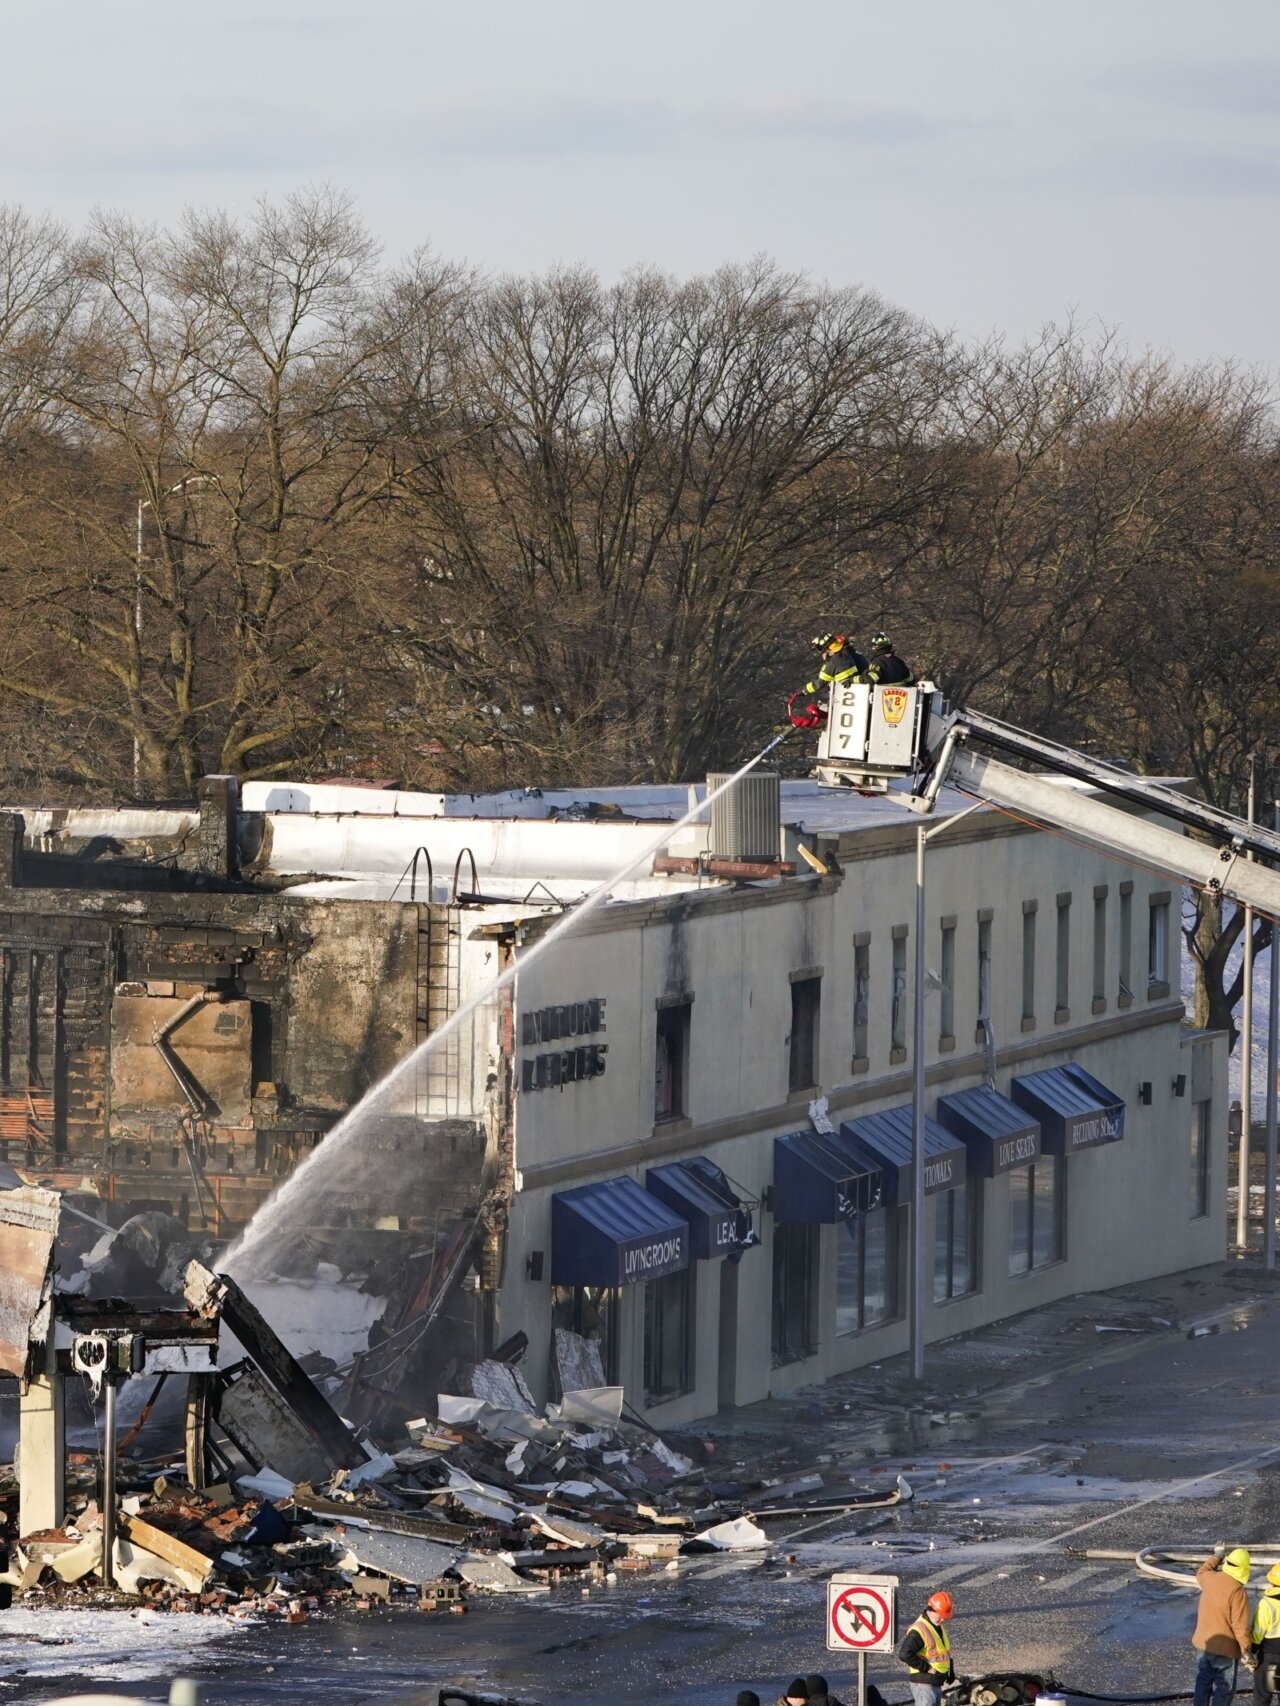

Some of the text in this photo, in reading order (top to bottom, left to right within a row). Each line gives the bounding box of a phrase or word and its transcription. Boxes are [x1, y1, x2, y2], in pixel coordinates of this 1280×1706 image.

[884, 690, 908, 698] LADDER
[895, 697, 901, 706] 2
[999, 1134, 1036, 1167] LOVE SEATS
[923, 1159, 953, 1189] TIONALS
